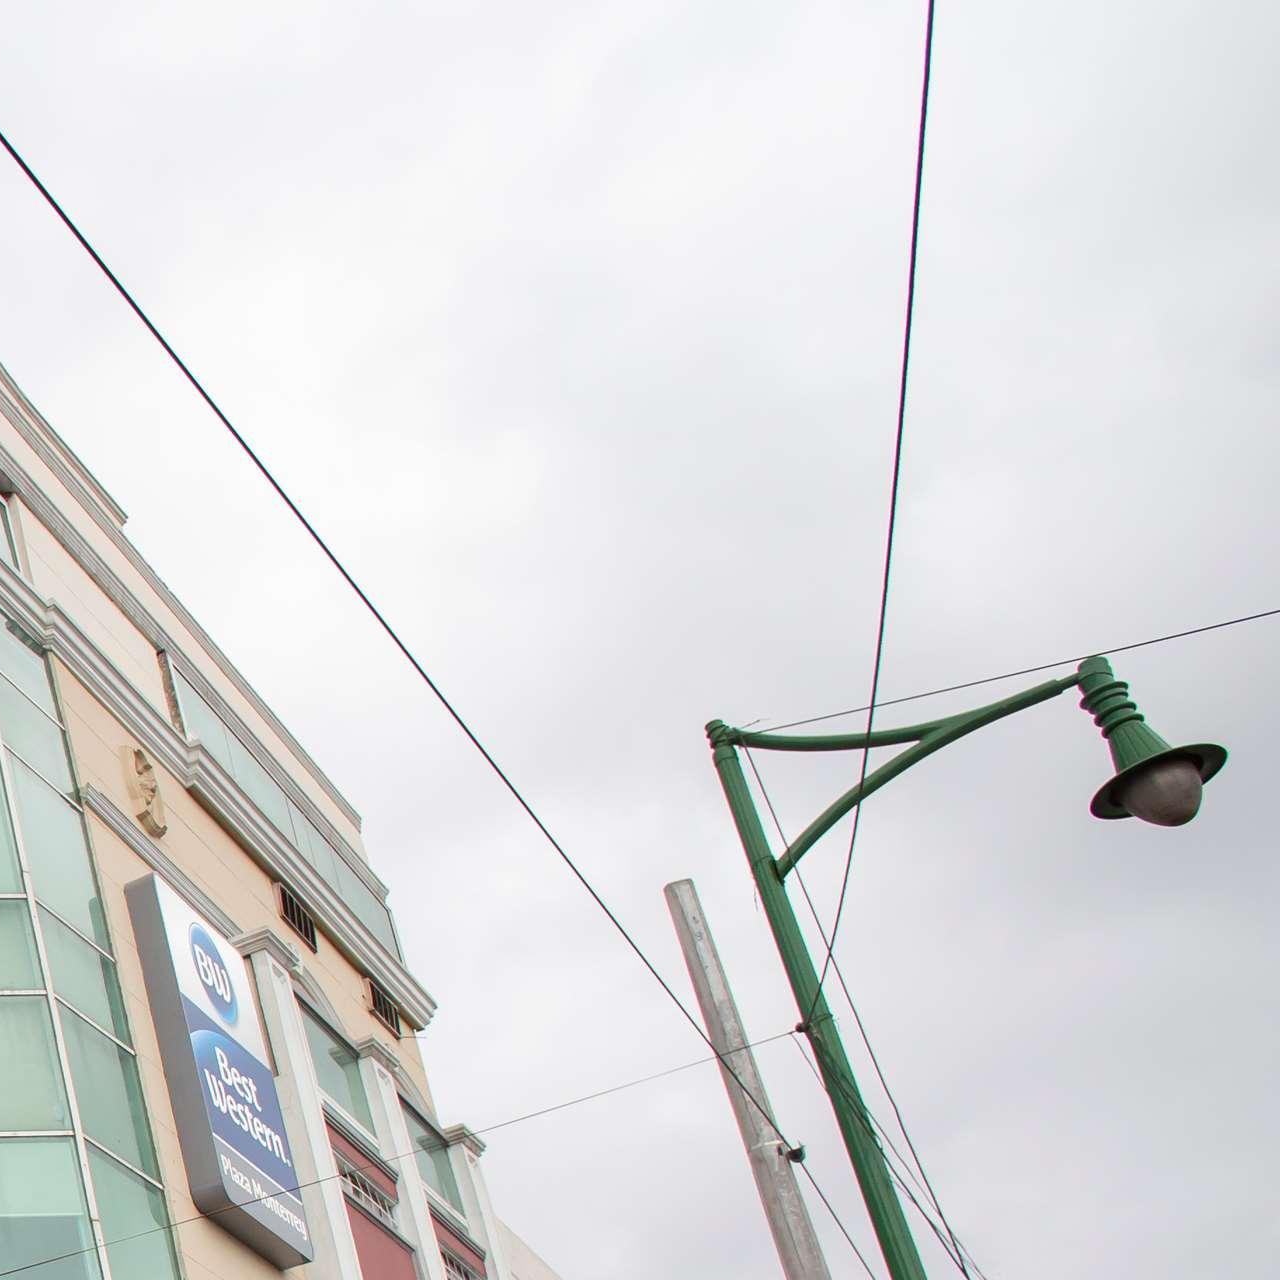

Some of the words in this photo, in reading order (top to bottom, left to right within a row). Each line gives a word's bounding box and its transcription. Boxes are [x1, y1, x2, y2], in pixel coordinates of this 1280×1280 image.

[193, 943, 231, 1003] BW
[215, 1046, 262, 1112] Best
[220, 1153, 253, 1195] Plaza
[252, 1178, 308, 1241] Monterrey
